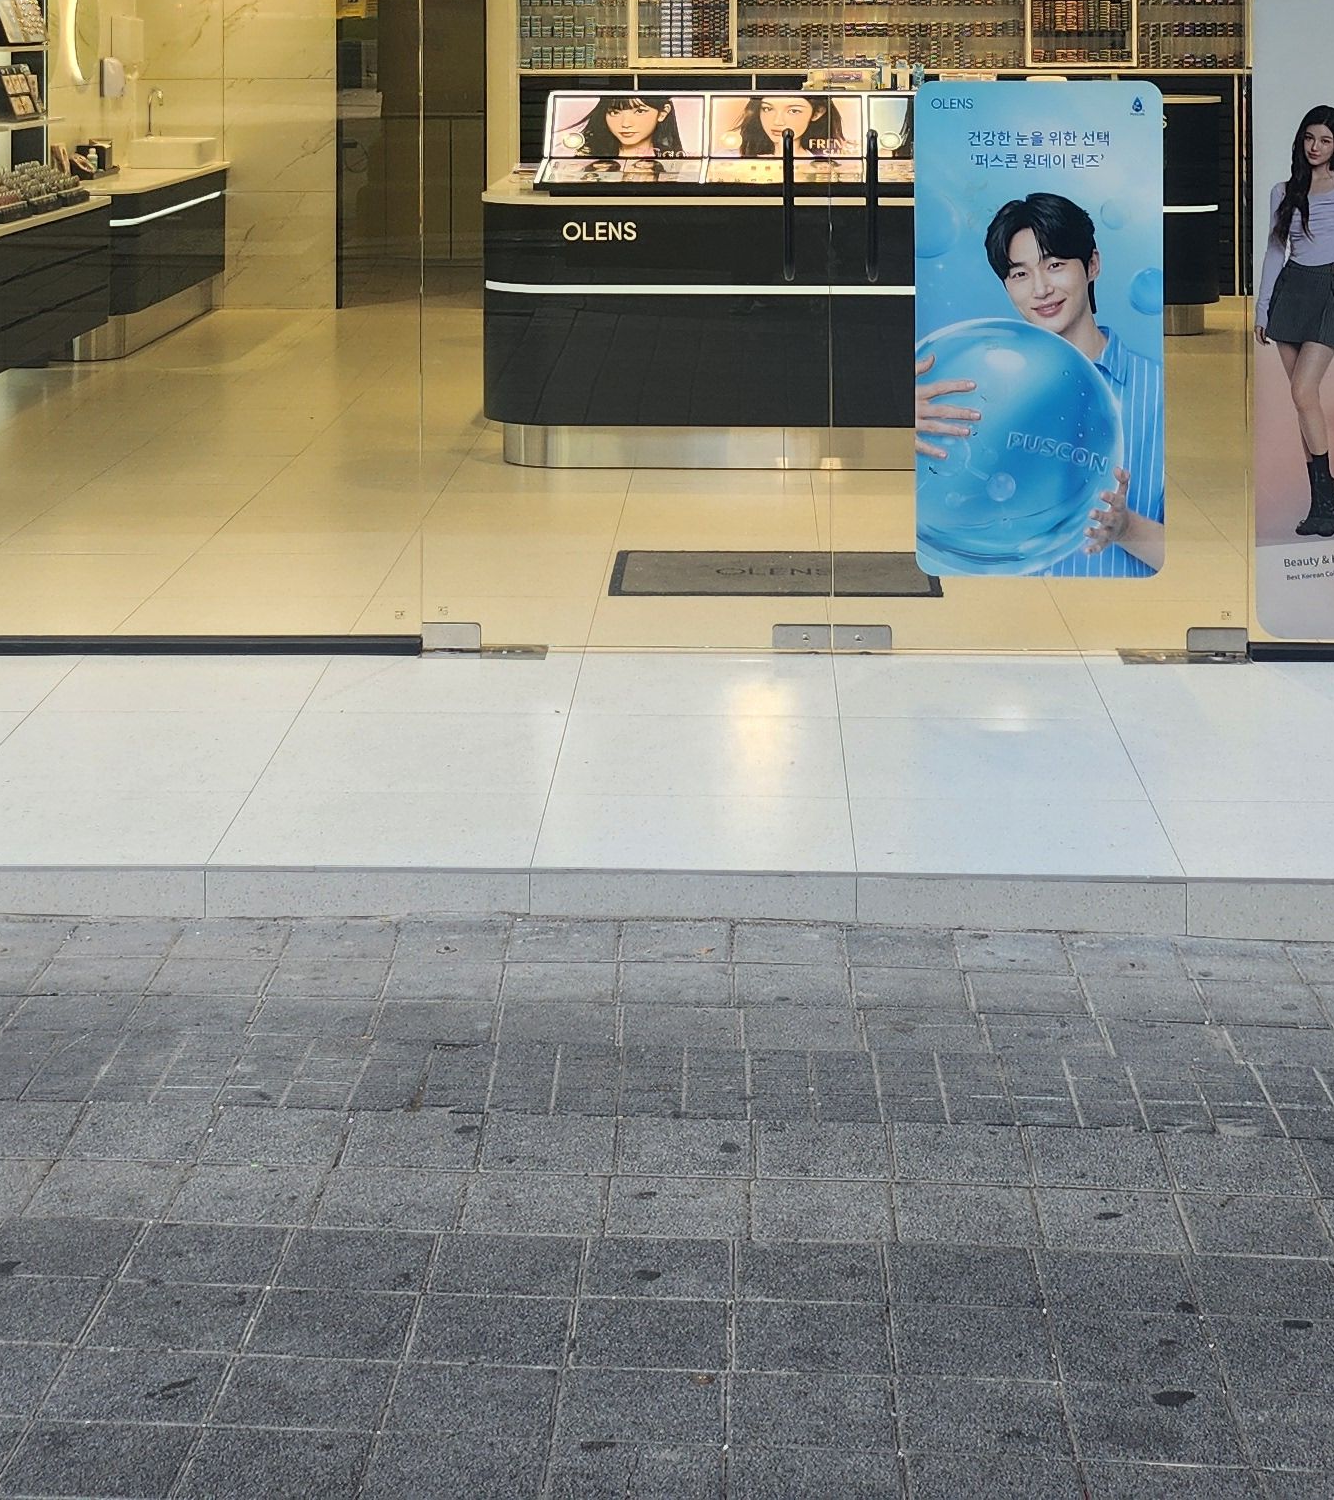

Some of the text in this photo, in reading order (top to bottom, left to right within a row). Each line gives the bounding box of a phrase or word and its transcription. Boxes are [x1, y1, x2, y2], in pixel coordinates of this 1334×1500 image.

[931, 98, 974, 110] OLENS
[968, 130, 1110, 147] 건강한 눈을 위한 선택
[1023, 153, 1066, 169] 원데이
[562, 222, 637, 242] OLENS
[1007, 432, 1109, 476] PUSCON
[1284, 556, 1320, 568] Beauty
[1322, 555, 1330, 564] &
